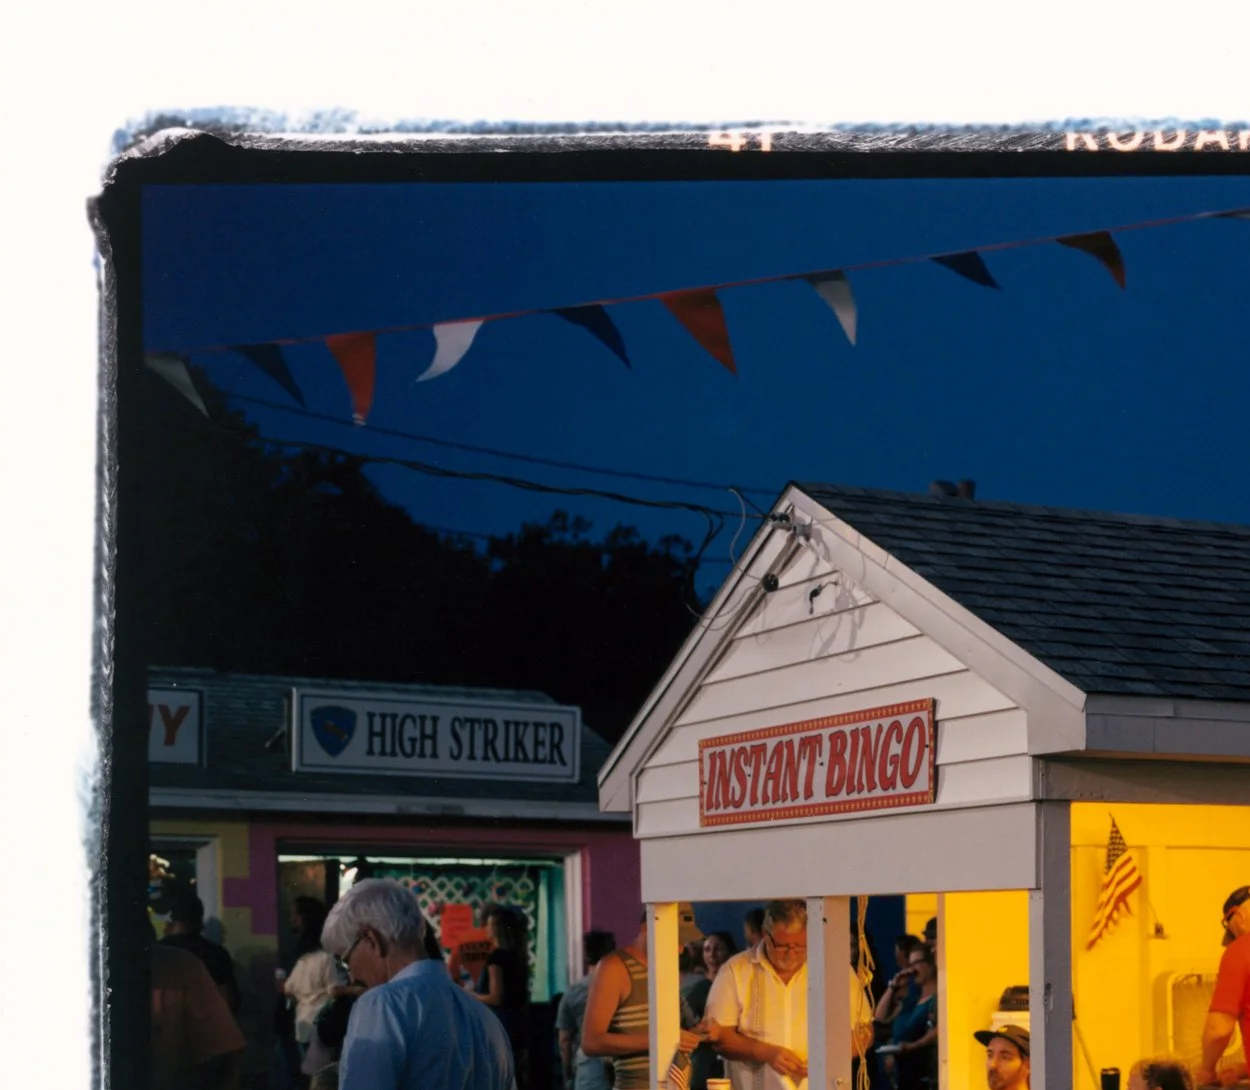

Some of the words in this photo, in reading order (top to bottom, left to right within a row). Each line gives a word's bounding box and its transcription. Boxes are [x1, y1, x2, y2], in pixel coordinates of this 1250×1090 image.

[365, 711, 440, 760] HIGH
[448, 715, 568, 767] STRIKER
[705, 733, 823, 812] INSTANT
[825, 716, 926, 798] BINGO
